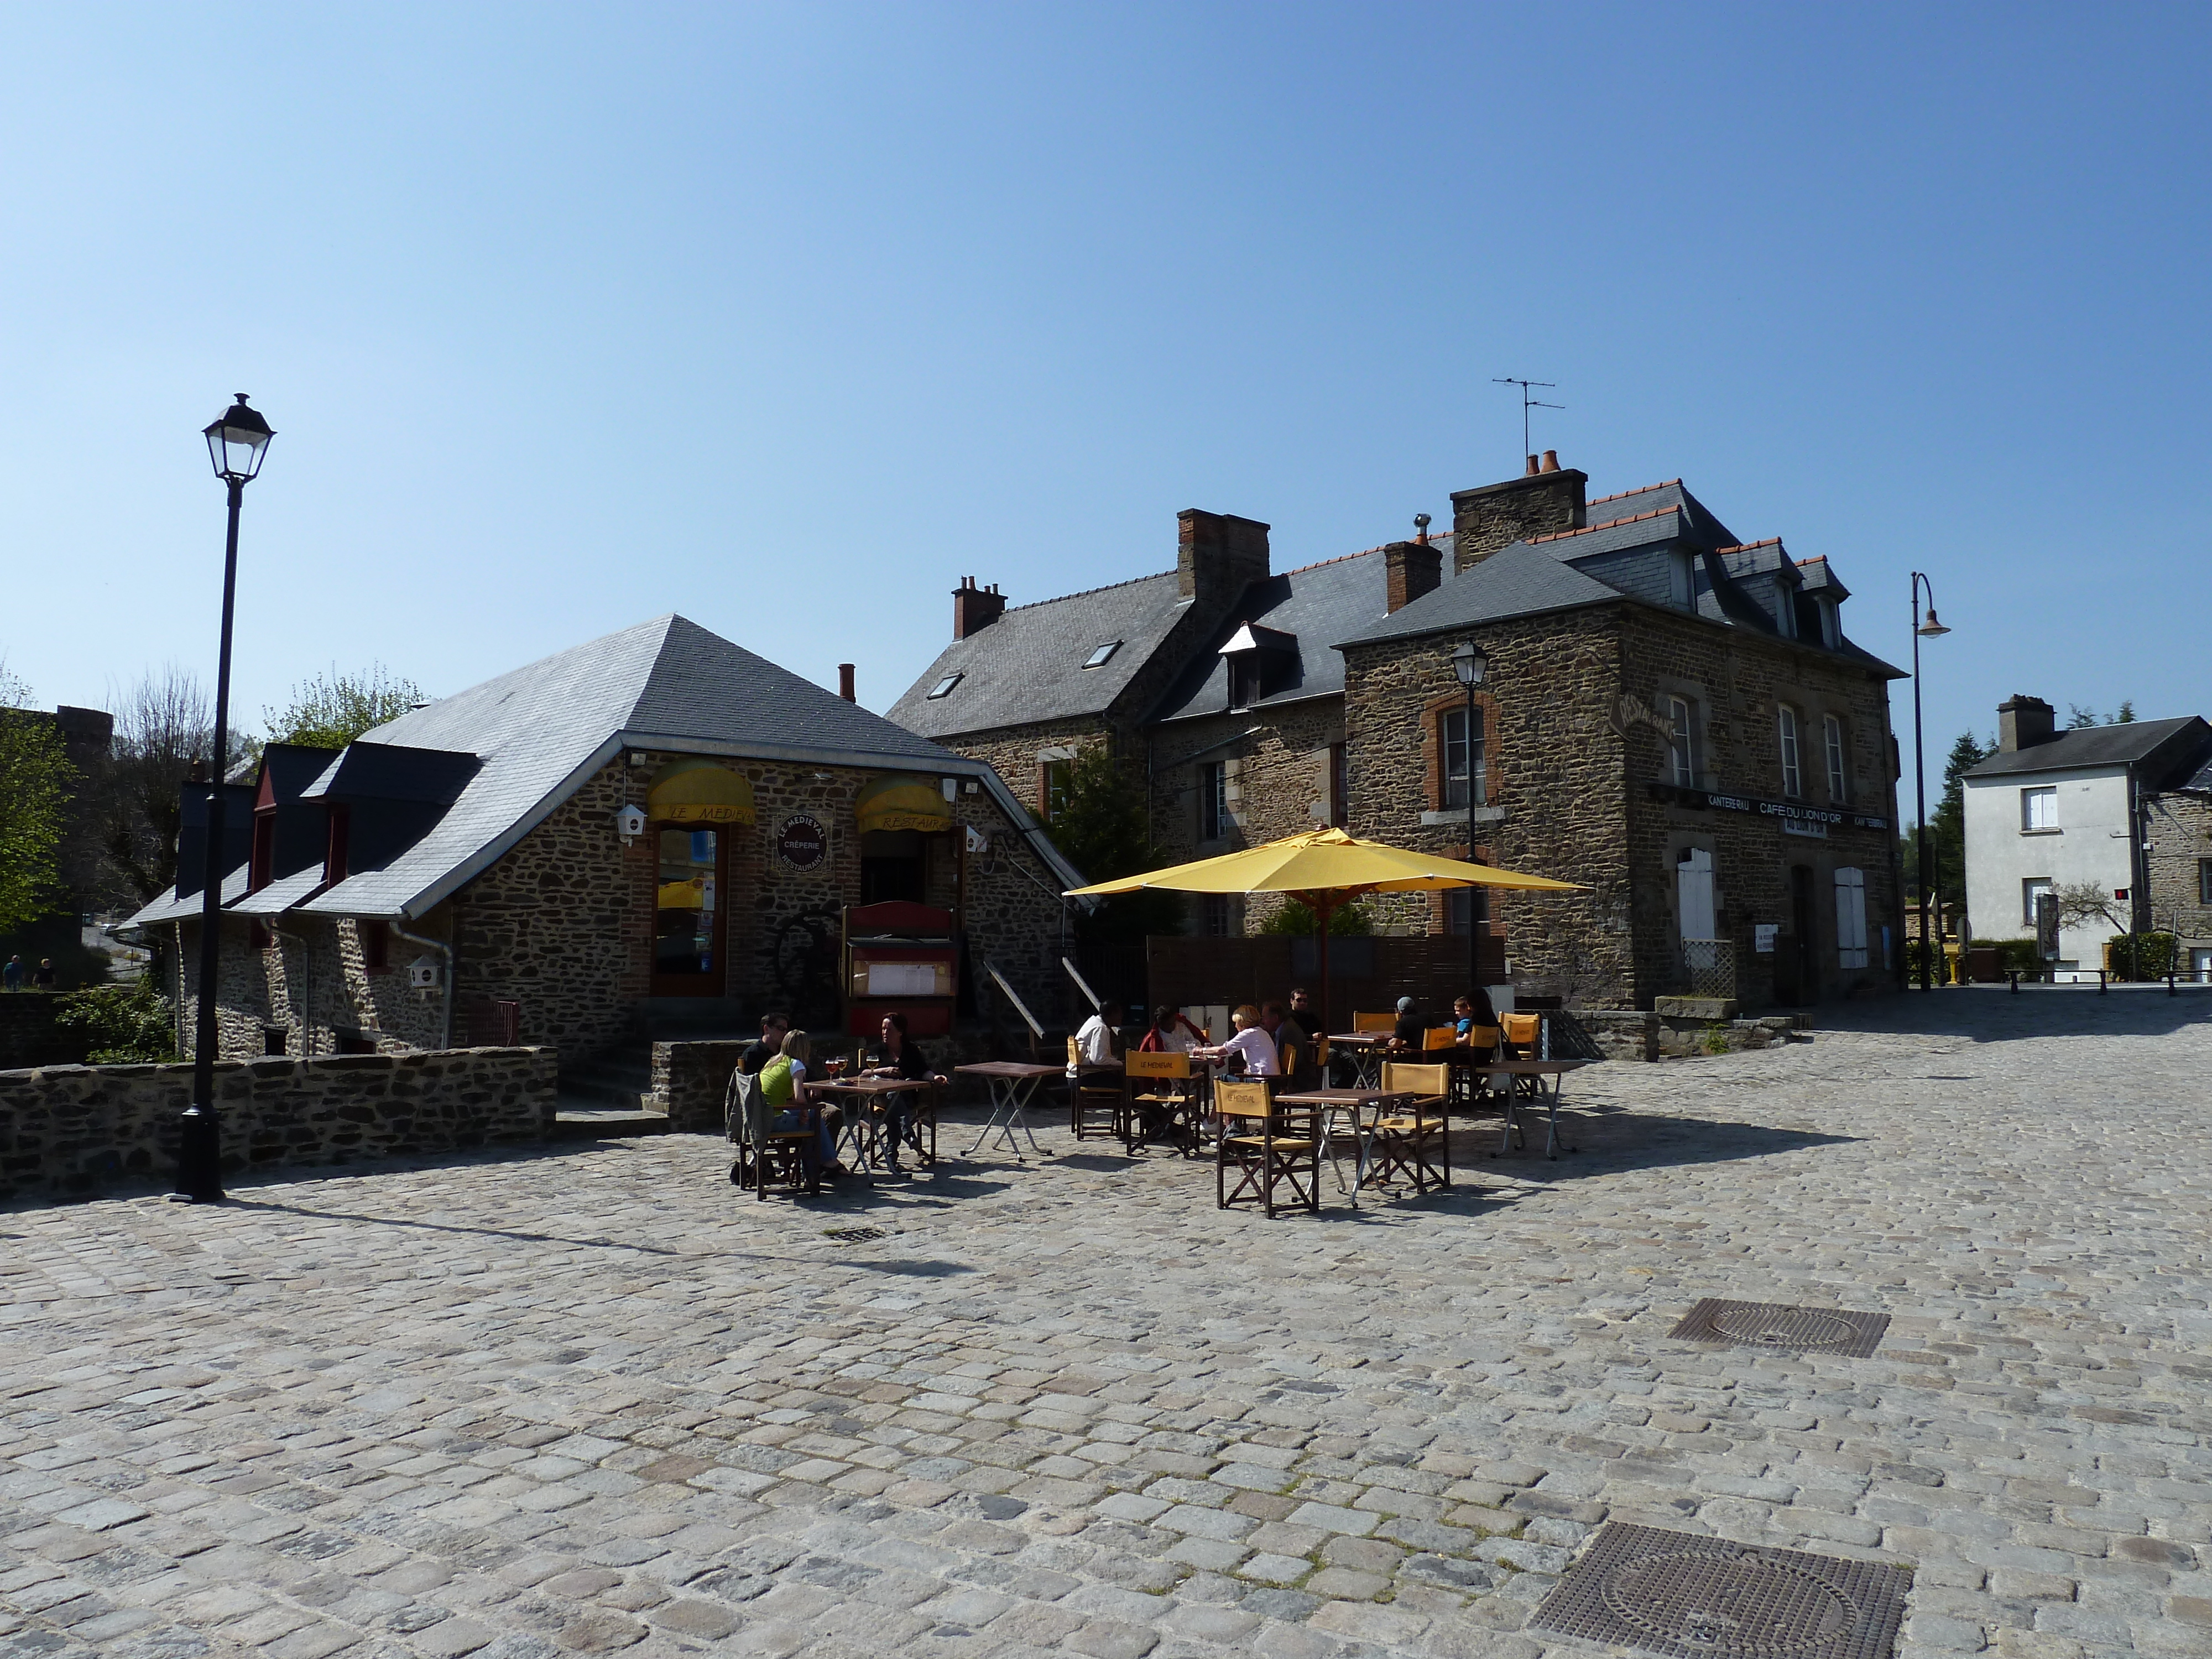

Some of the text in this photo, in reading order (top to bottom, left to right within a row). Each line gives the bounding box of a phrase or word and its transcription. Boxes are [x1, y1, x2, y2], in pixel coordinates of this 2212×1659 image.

[671, 808, 686, 818] LE
[1787, 807, 1799, 818] DU
[1821, 812, 1841, 824] D'OR
[779, 816, 825, 840] LE MEDIEVAL
[784, 840, 820, 849] CRÊPERIE
[781, 853, 823, 872] RESTAURANT
